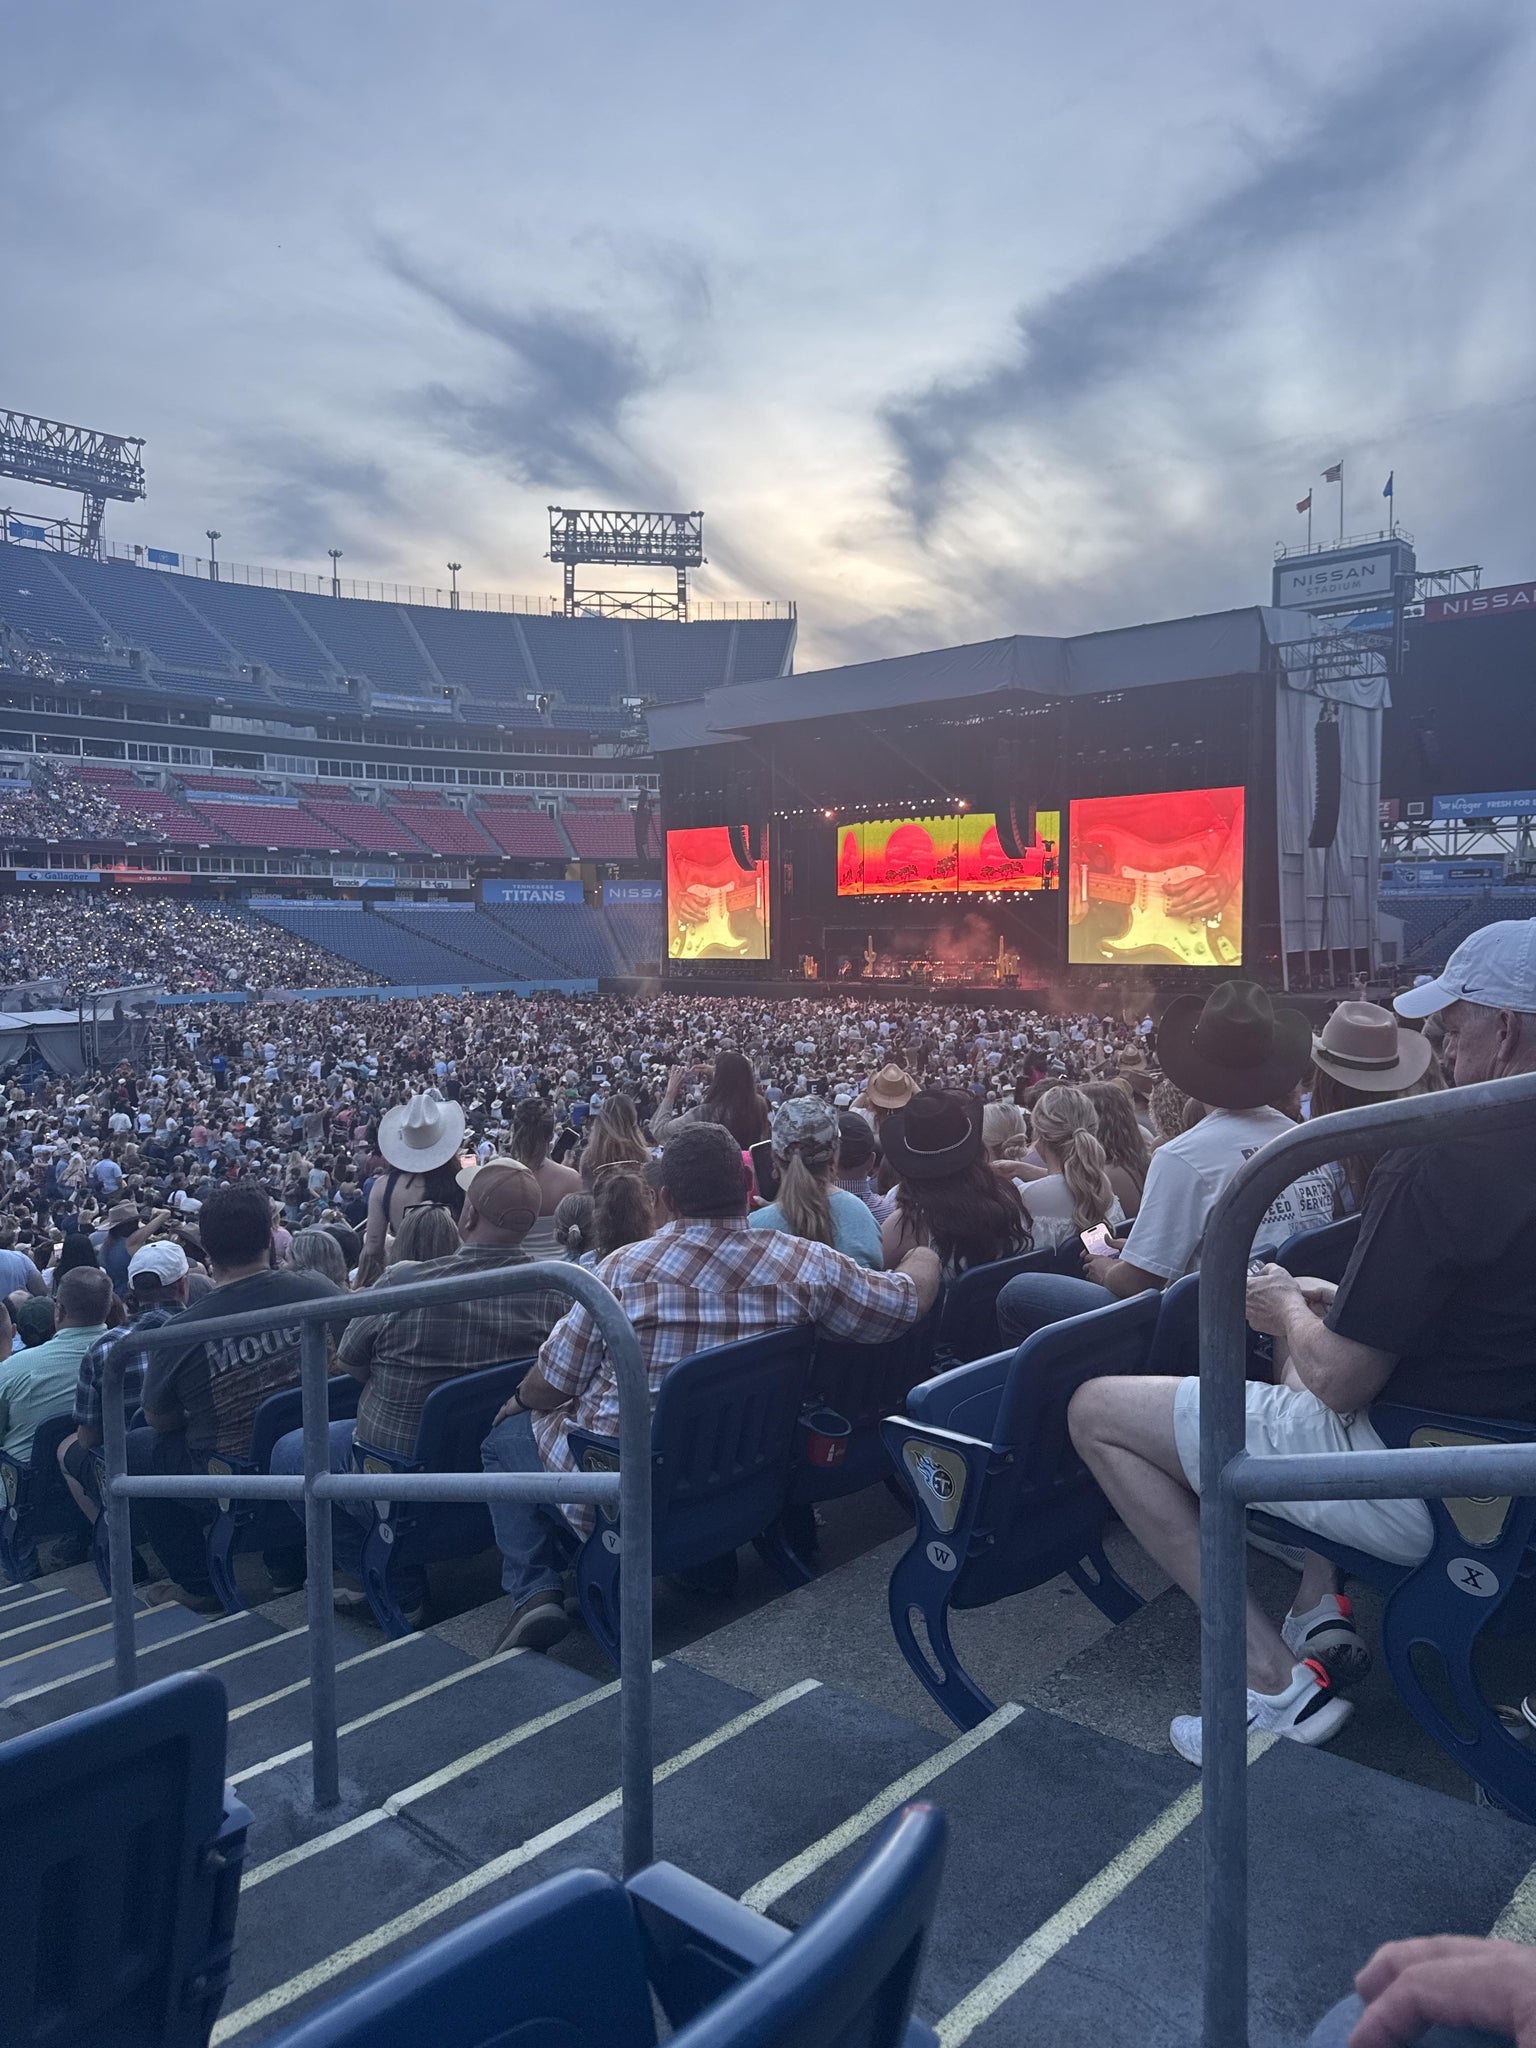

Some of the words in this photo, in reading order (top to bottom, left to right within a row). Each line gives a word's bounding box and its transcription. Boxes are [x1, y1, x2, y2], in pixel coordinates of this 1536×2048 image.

[1293, 565, 1375, 587] NISSAN
[1305, 580, 1361, 597] STADIUM
[1443, 589, 1536, 615] NISSA
[1452, 798, 1482, 814] Kroger
[1487, 800, 1512, 808] FRESH
[1514, 798, 1530, 807] FOR
[44, 872, 89, 882] Gallagher
[502, 889, 566, 901] TITANS
[596, 1065, 604, 1074] D
[811, 1084, 818, 1094] E
[934, 1546, 950, 1565] W
[1461, 1565, 1484, 1590] X
